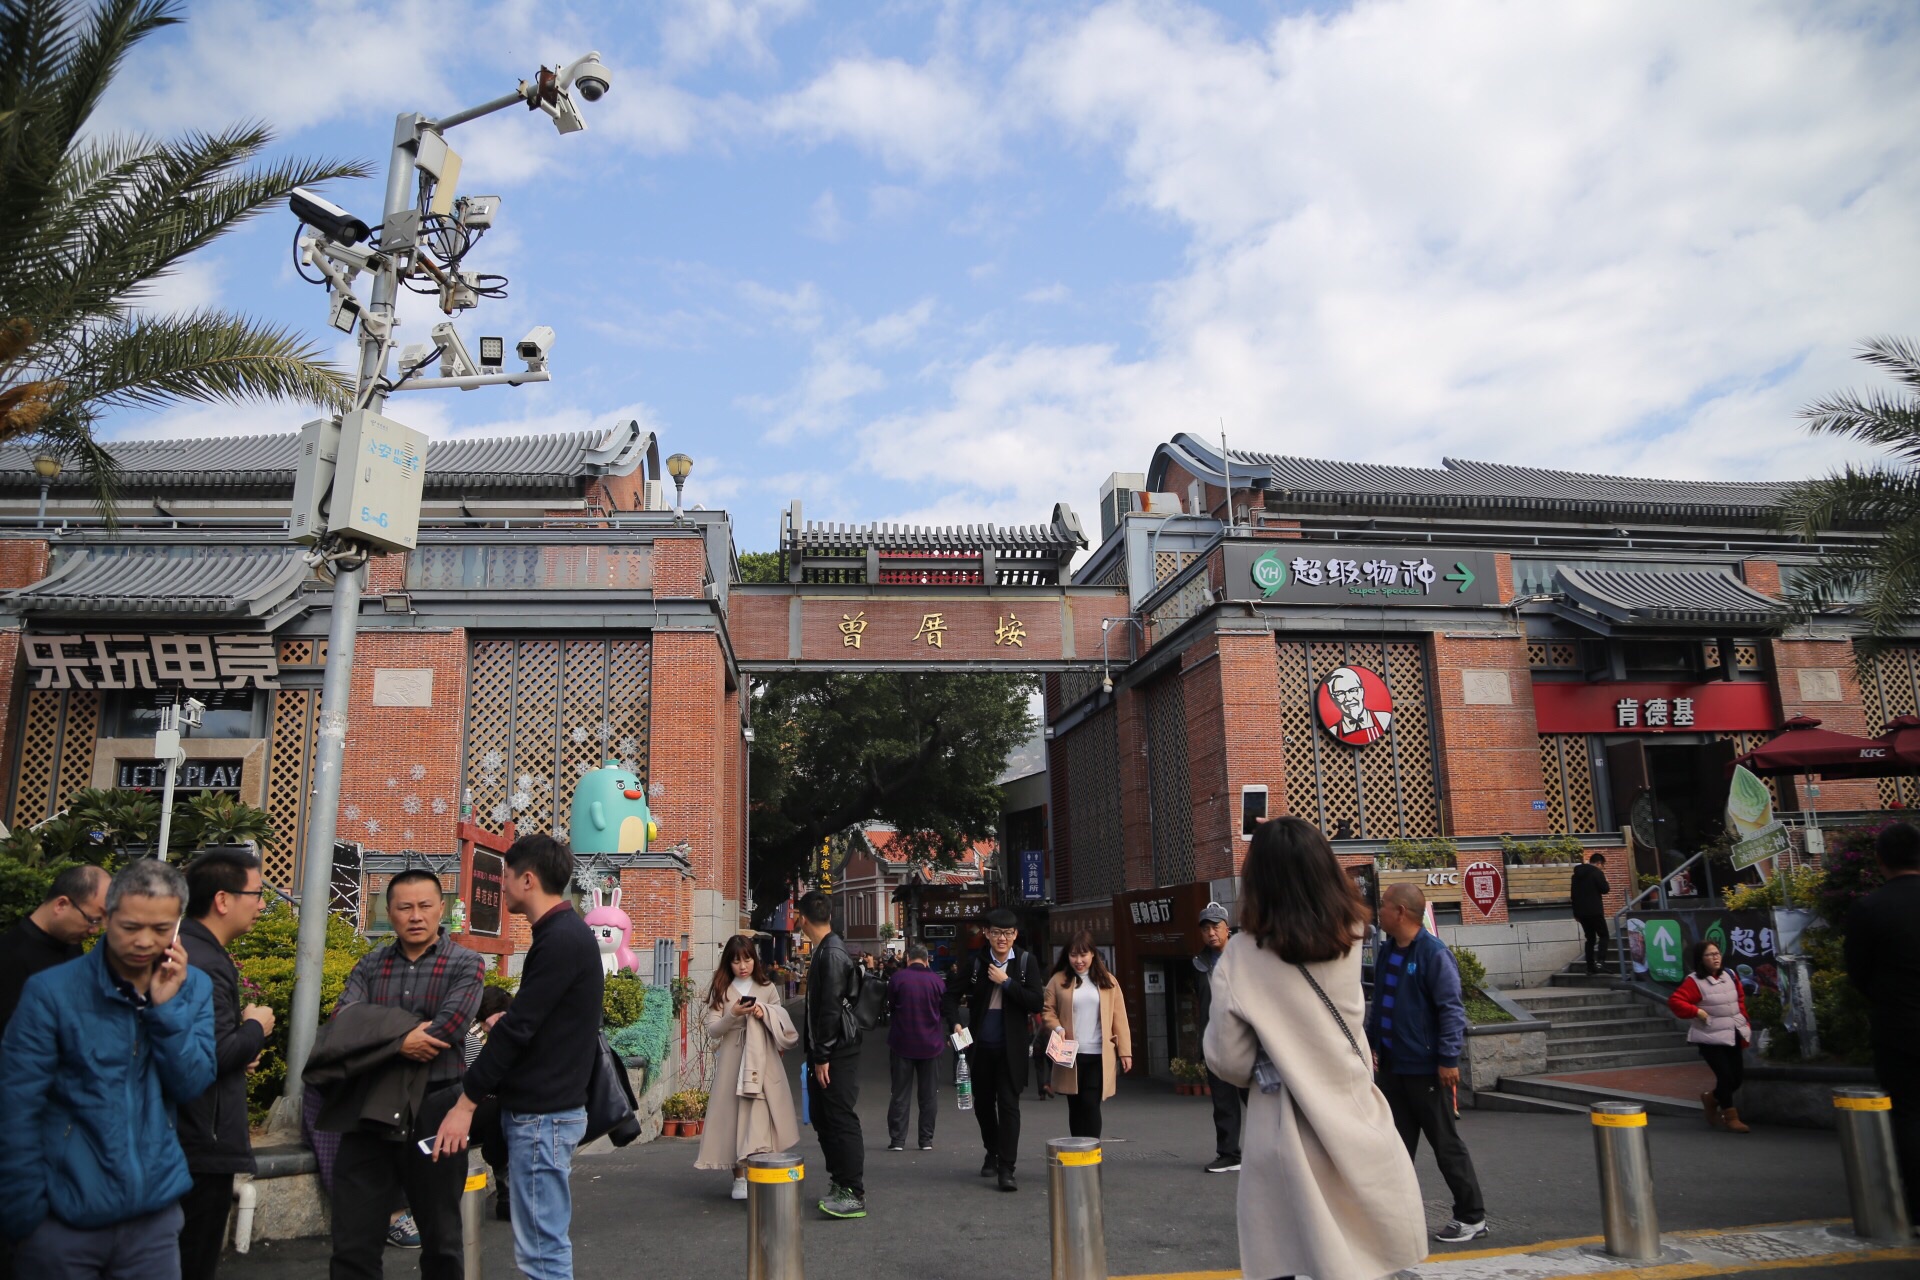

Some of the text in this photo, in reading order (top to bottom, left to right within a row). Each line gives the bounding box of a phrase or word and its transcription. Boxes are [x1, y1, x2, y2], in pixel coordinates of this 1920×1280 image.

[1260, 566, 1279, 579] YH
[1290, 556, 1437, 595] 超级物种
[1349, 586, 1421, 597] Super Species
[838, 611, 1027, 649] 曾厝垵
[22, 634, 281, 689] 乐玩电竞
[1617, 698, 1695, 727] 肯德基
[1860, 748, 1886, 758] KFC
[120, 766, 241, 788] LETS PLAY
[1426, 872, 1460, 886] KFC
